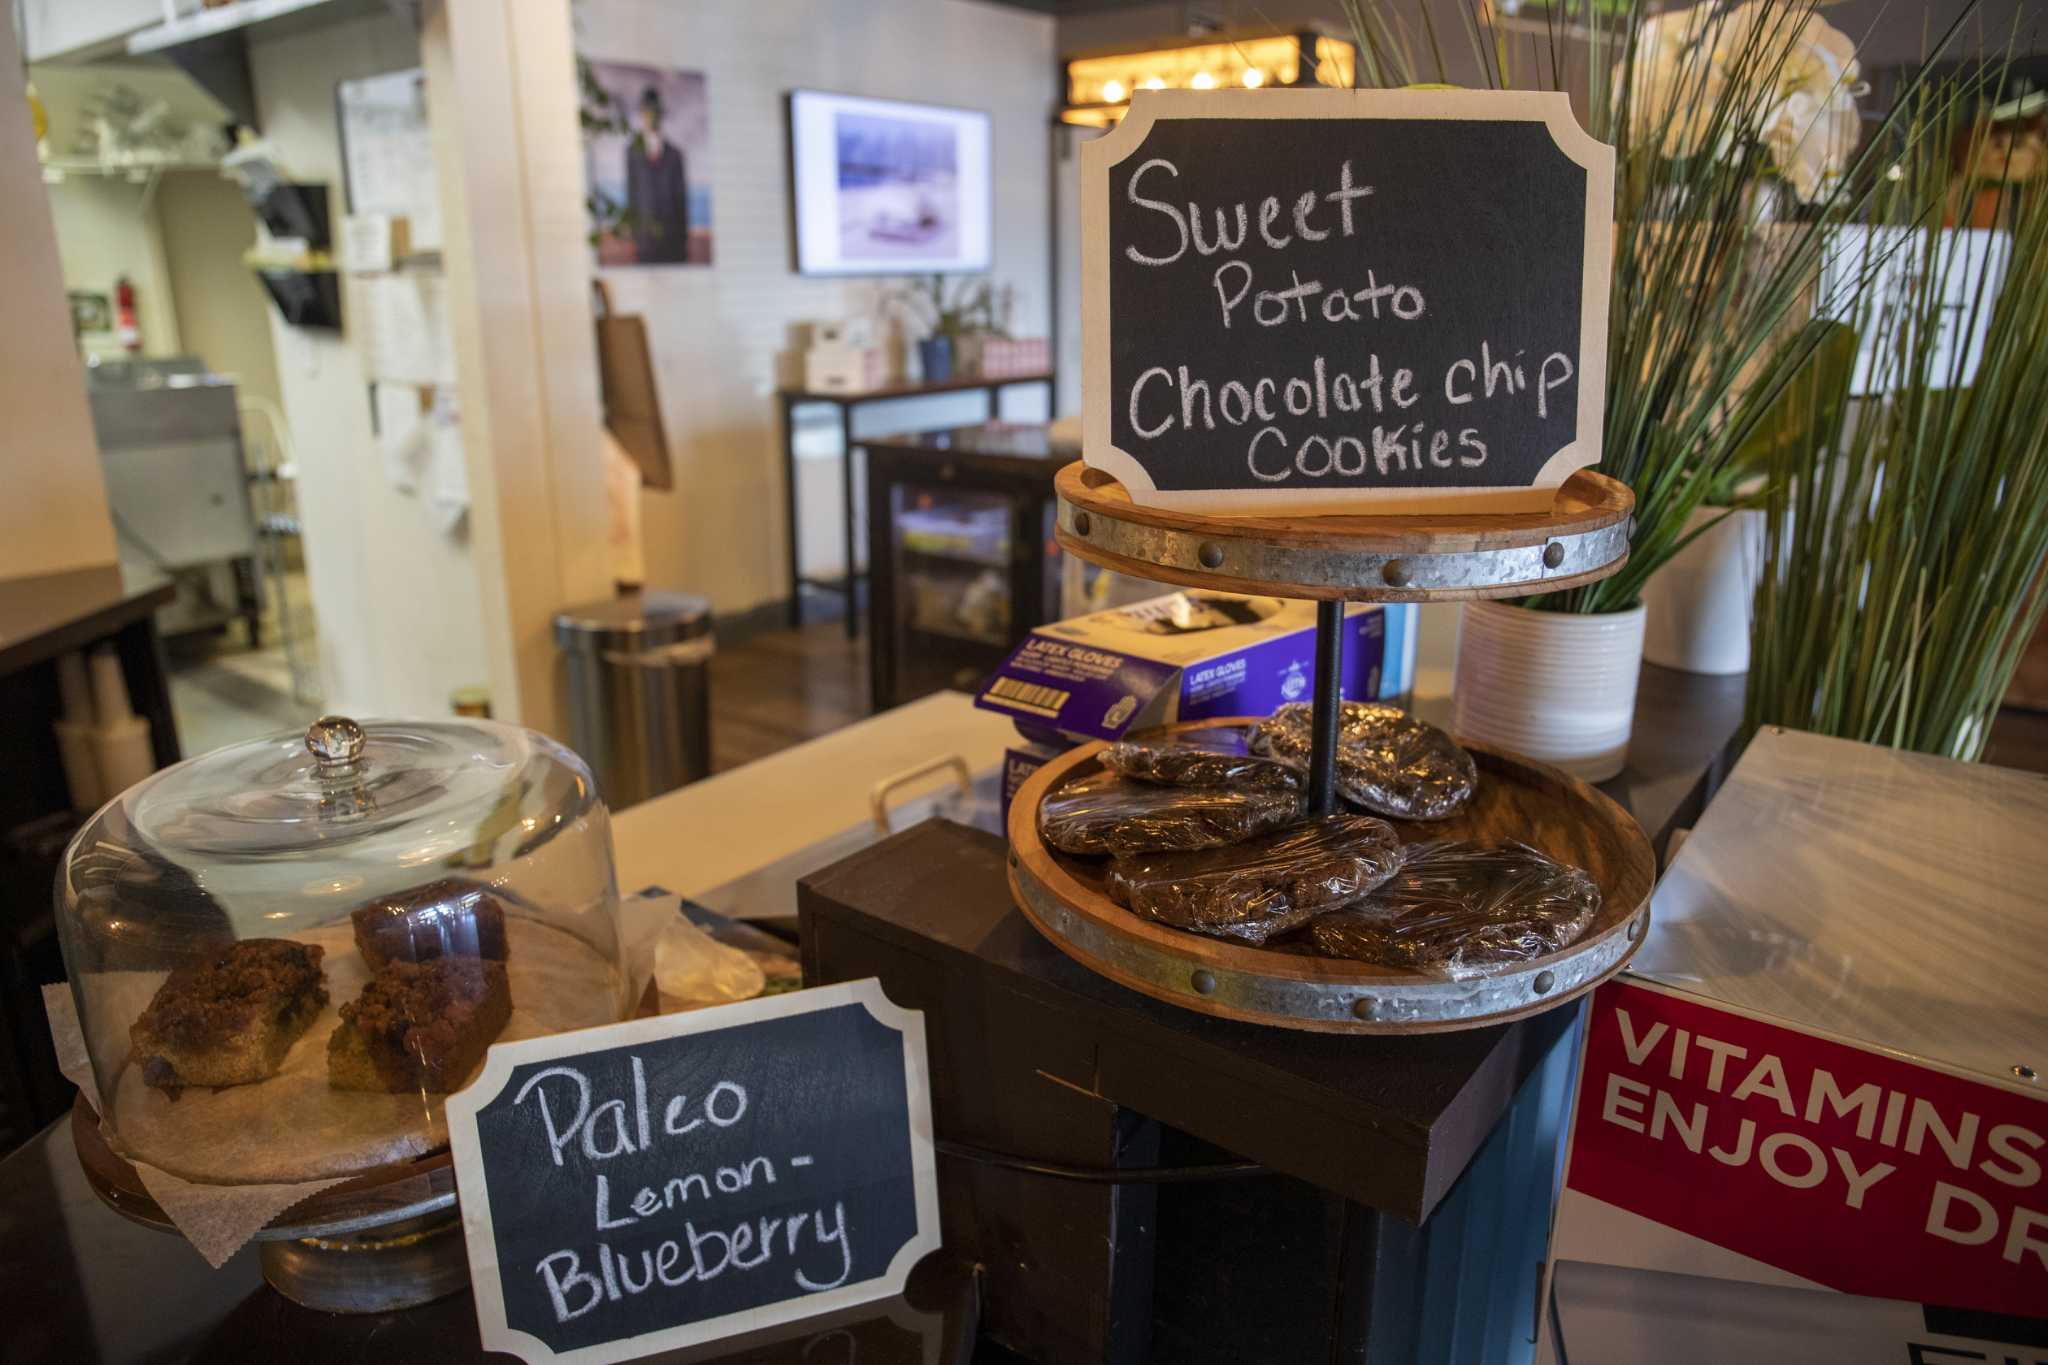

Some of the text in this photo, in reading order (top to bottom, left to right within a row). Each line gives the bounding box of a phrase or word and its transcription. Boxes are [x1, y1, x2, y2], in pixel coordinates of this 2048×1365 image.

[1126, 159, 1377, 266] Sweet
[1212, 260, 1426, 329] Potato
[1129, 355, 1420, 439] Chocolate
[1248, 421, 1488, 482] Cookies
[514, 1056, 748, 1166] Paleo
[1602, 1072, 1896, 1210] ENJOY
[1614, 1007, 2047, 1188] VITAMINS
[535, 1201, 852, 1323] Blueberry
